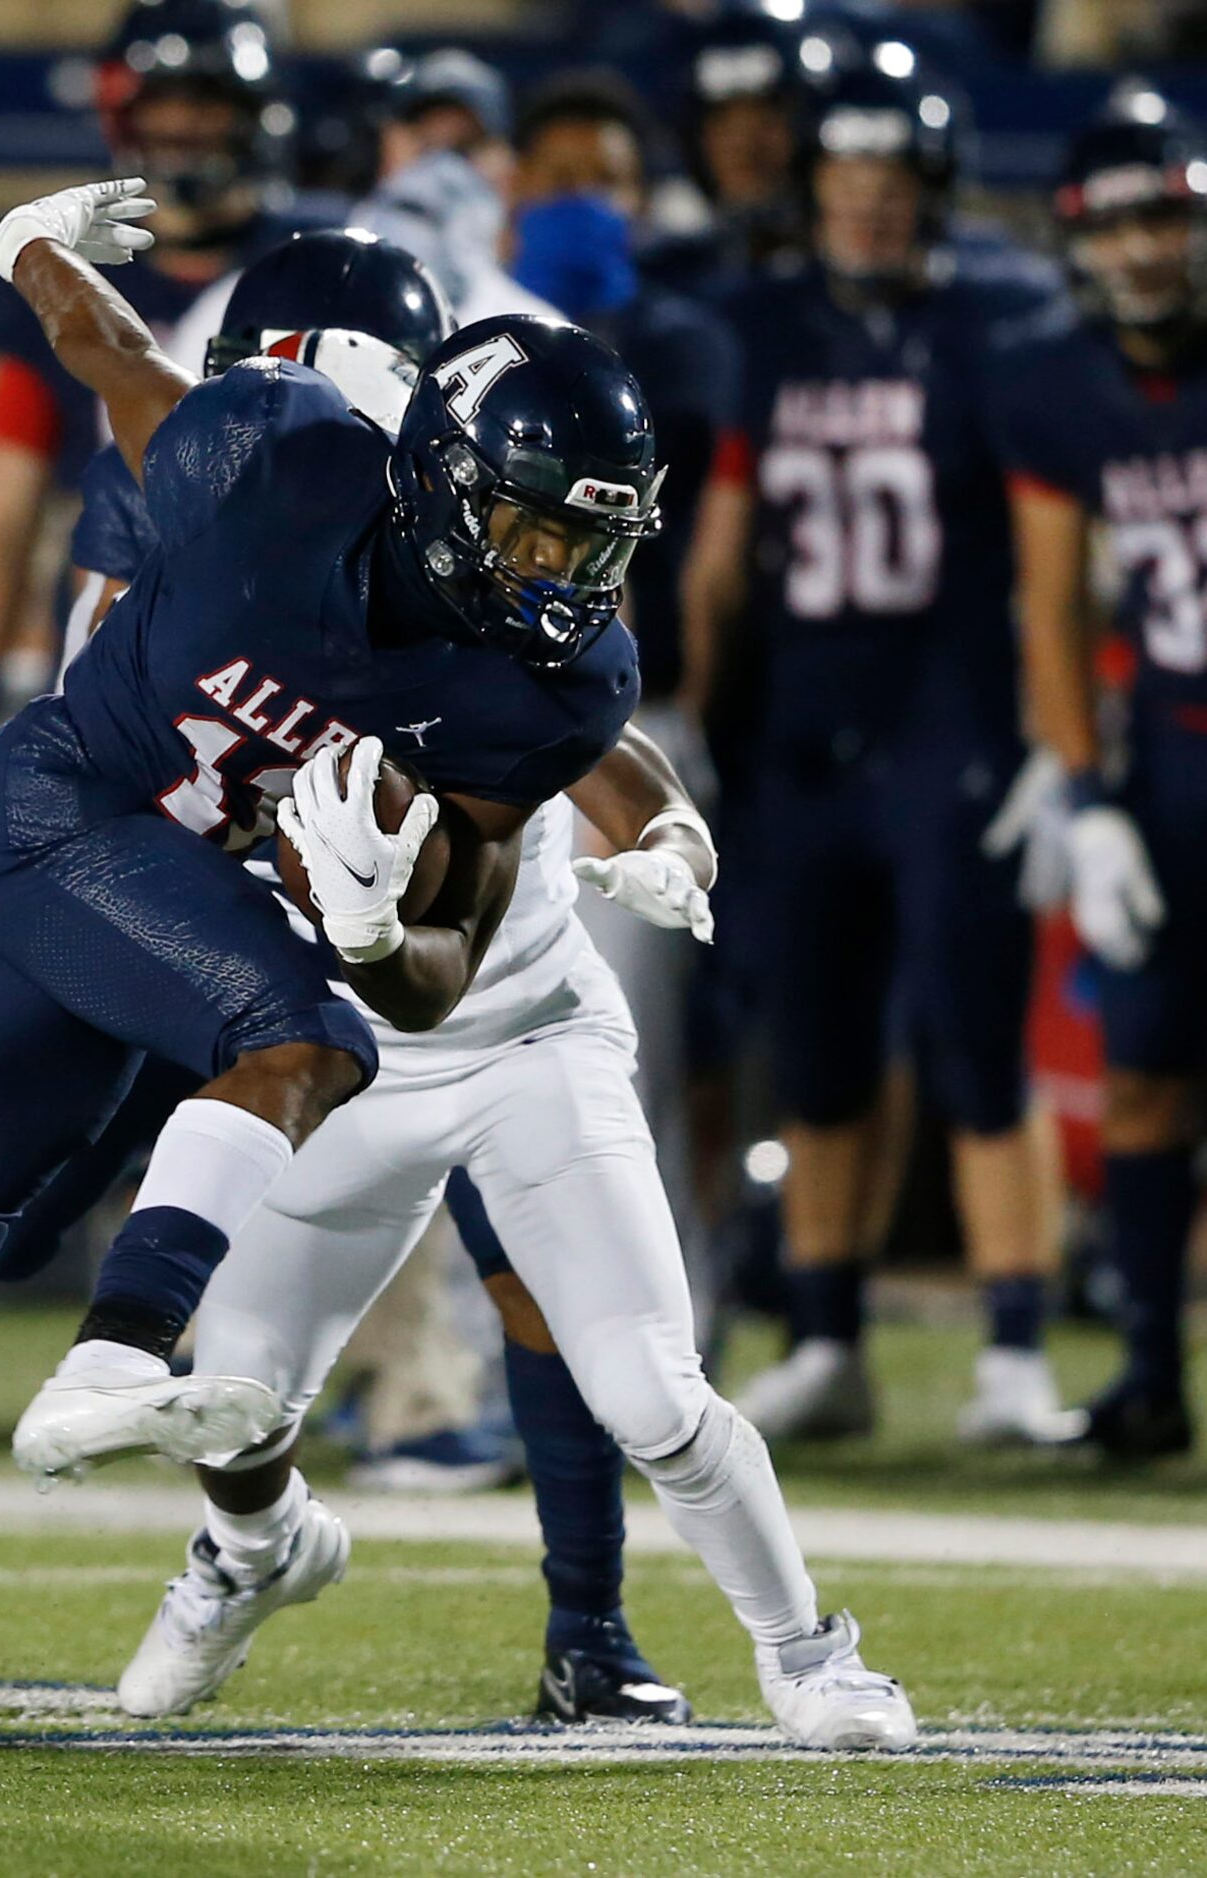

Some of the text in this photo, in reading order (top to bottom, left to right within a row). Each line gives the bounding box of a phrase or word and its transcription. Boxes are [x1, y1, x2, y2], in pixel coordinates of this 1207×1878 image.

[430, 333, 529, 428] A
[757, 448, 943, 618] 30
[1093, 522, 1207, 675] 3
[195, 657, 361, 762] ALLE
